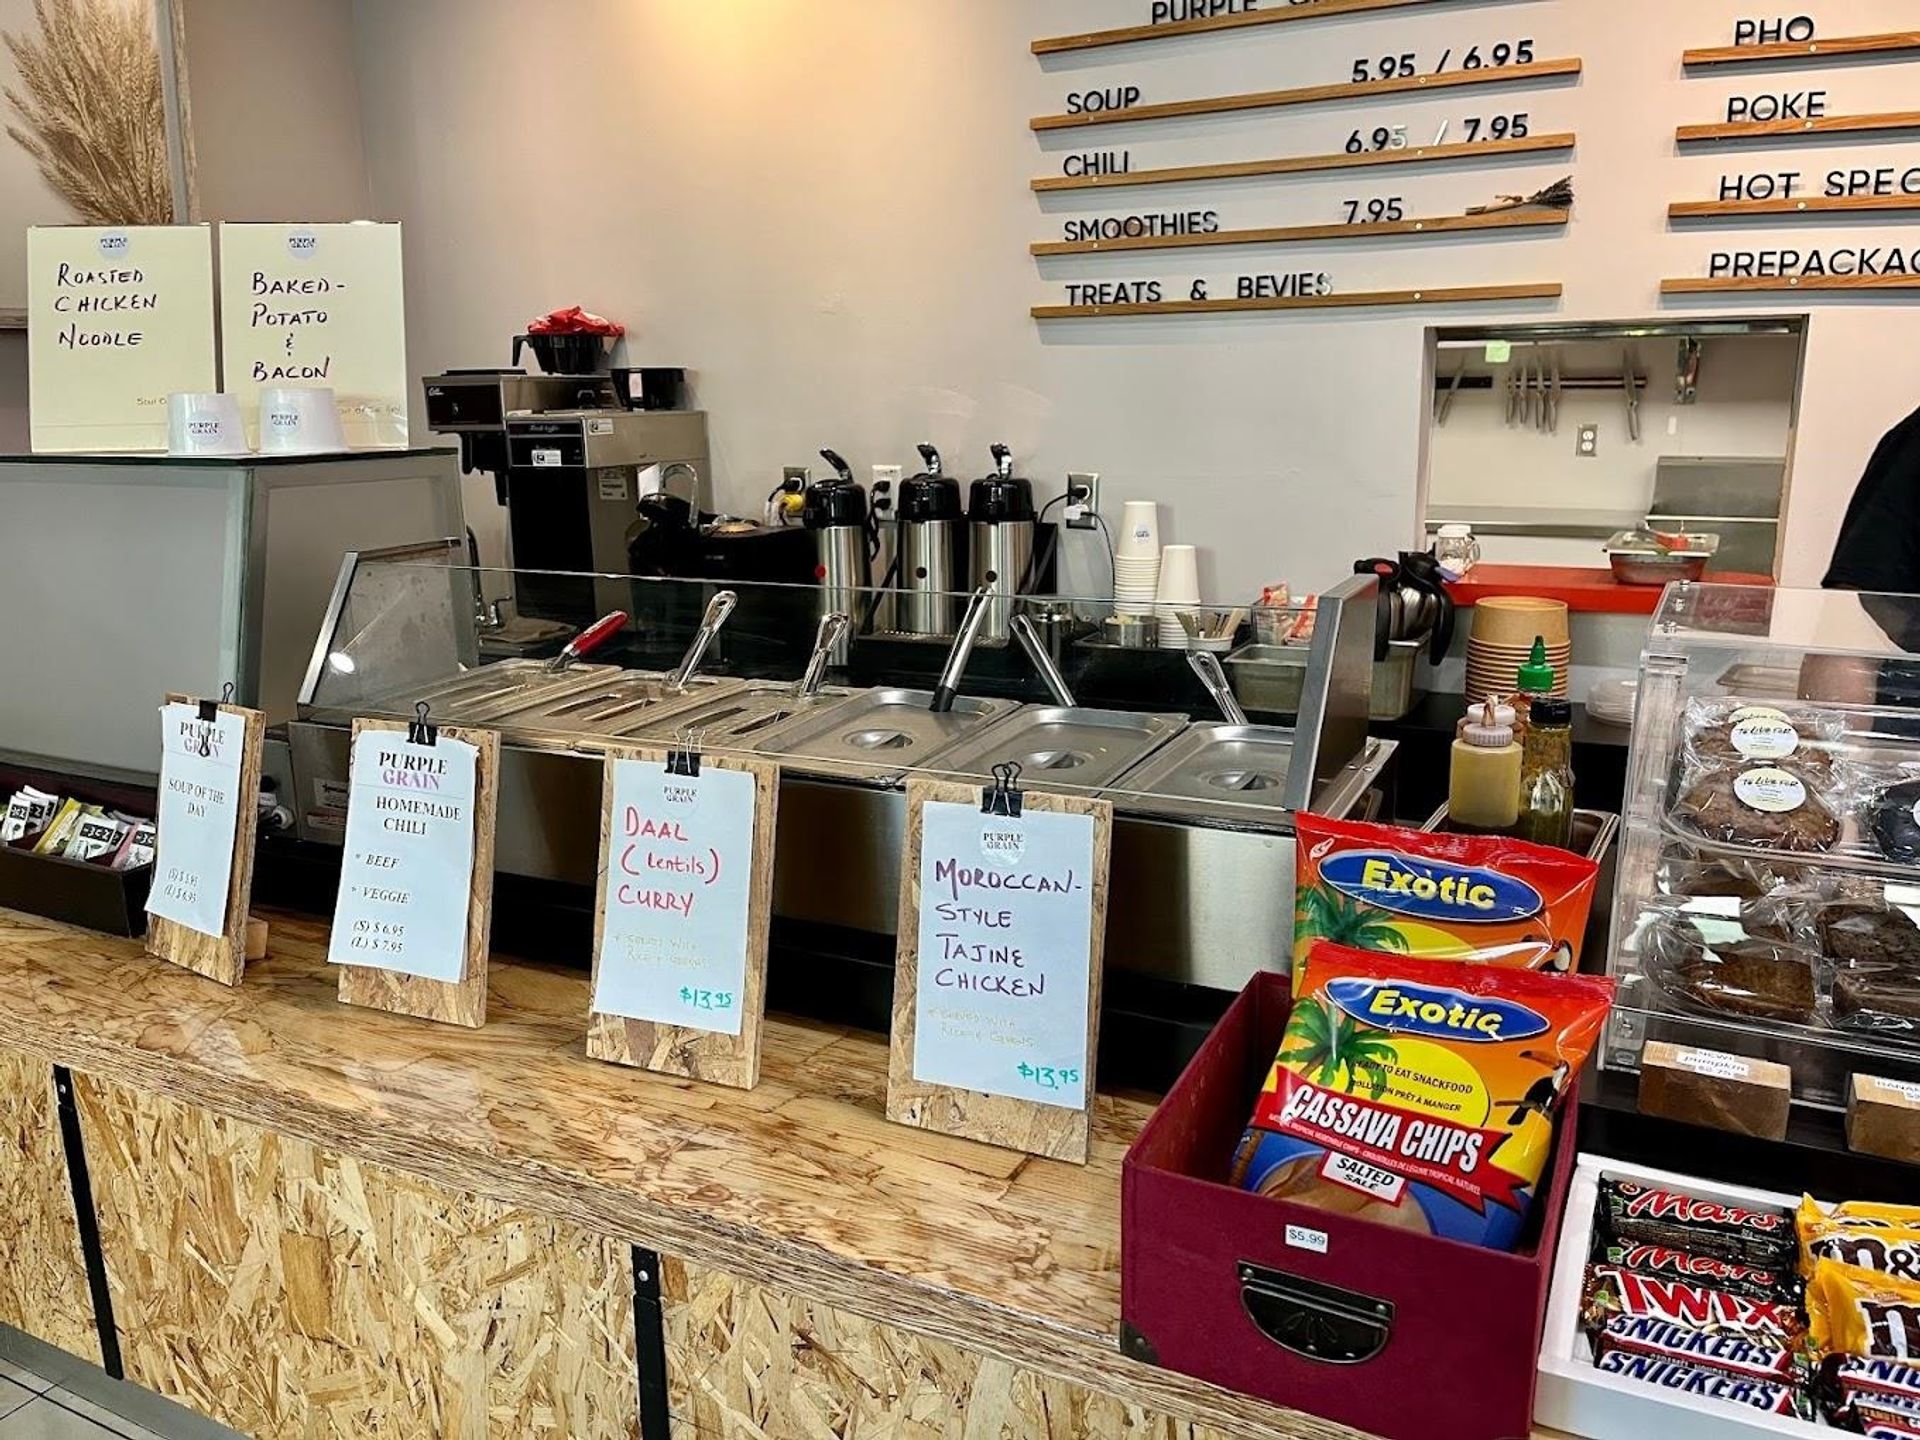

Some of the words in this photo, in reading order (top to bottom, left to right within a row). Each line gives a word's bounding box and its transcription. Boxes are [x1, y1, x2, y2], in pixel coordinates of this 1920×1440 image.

[1734, 15, 1815, 46] PHO
[1351, 53, 1416, 83] 5.95
[1434, 49, 1452, 74] /
[1463, 39, 1534, 70] 6.95
[1066, 86, 1141, 115] SOUP
[1726, 91, 1827, 123] POKE
[1345, 124, 1408, 154] 6.95
[1464, 112, 1529, 144] 7.95
[1063, 150, 1130, 177] CHILI
[1719, 172, 1801, 201] HOT
[1343, 197, 1403, 225] 7.95
[1064, 211, 1219, 242] SMOOTHIES
[57, 262, 144, 288] ROASTED
[1065, 281, 1162, 307] TREATS
[1190, 279, 1208, 302] &
[1237, 272, 1333, 299] BEVIES
[54, 293, 158, 313] CHICKEN
[251, 302, 328, 328] POTATO
[58, 322, 143, 350] NOODLE
[252, 355, 331, 383] BACON
[379, 751, 448, 776] PURPLE
[168, 778, 194, 795] SOUP
[194, 785, 207, 800] OF
[382, 769, 441, 791] GRAIN
[375, 795, 463, 822] HOMEMADE
[383, 817, 427, 836] CHILI
[624, 805, 689, 842] DAAL
[983, 831, 1024, 843] PURPLE
[365, 853, 400, 870] BEEF
[361, 887, 411, 905] VEGGIE
[1361, 858, 1497, 910] Exotic
[618, 884, 694, 918] CURRY
[935, 902, 1012, 928] STYLE
[353, 920, 370, 933] (S)
[382, 924, 405, 937] 6.95
[936, 933, 1025, 968] TAJINE
[934, 967, 1045, 996] CHICKEN
[1368, 989, 1505, 1033] Exotic
[1016, 1061, 1080, 1090] $13.95
[1394, 1066, 1412, 1079] EAT
[1412, 1071, 1474, 1095] SNACKFOOD
[1286, 1084, 1402, 1151] CASSAVA
[1400, 1116, 1484, 1173] CHIPS
[1336, 1156, 1396, 1188] SALTED
[1626, 1187, 1784, 1230] Mars
[1288, 1227, 1326, 1247] $5.99
[1626, 1244, 1776, 1286] Mars
[1608, 1314, 1779, 1370] SNICKERS
[1600, 1350, 1783, 1412] SNICKERS
